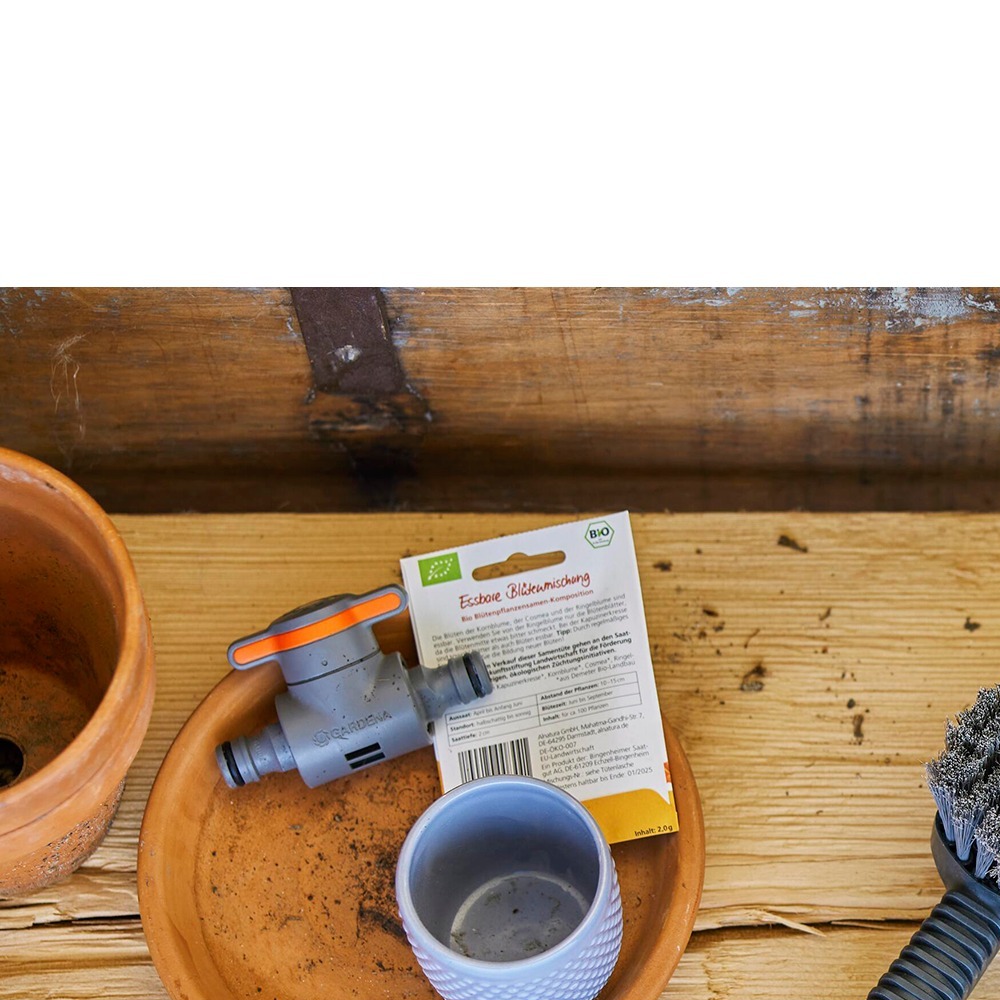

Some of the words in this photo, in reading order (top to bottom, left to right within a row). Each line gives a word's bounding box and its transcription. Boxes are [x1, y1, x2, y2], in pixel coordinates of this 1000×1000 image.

[460, 593, 501, 608] Essbare
[506, 574, 590, 598] Blütenmischung
[475, 591, 593, 618] Blütenpflanzensamen-Komposition
[477, 622, 512, 631] Kornblume,
[525, 613, 549, 621] Cosmea
[576, 598, 611, 609] Ringelblume
[573, 624, 590, 632] Durch
[591, 615, 628, 626] regelmäßiges
[455, 640, 489, 651] Blütenmitte
[581, 609, 627, 622] Kapuzinerkresse
[456, 633, 490, 643] Verwenden
[526, 617, 563, 628] Ringelblume
[492, 658, 516, 667] Verkauf
[538, 646, 570, 657] Samentüte
[572, 641, 591, 649] gehen
[502, 647, 524, 655] Bildung
[544, 636, 564, 646] Blüten!
[490, 662, 532, 674] kunftsstiftung
[533, 650, 578, 665] Landwirtschaft
[600, 638, 632, 648] Förderung
[510, 665, 550, 677] ökologischen
[552, 649, 616, 667] Züchtungsinitiativen.
[571, 669, 596, 679] Demeter
[598, 661, 635, 672] Bio-Landbau
[541, 692, 563, 700] Abstand
[542, 702, 566, 711] Blütezeit:
[587, 692, 613, 700] September
[330, 711, 392, 739] GARDENA
[477, 717, 506, 725] halbschattig
[539, 736, 566, 746] DE-64295
[567, 730, 597, 740] Darmstadt,
[598, 723, 628, 733] alnatura.de
[540, 742, 576, 755] DE-ÖKO-007
[541, 746, 594, 761] EU-Landwirtschaft
[552, 759, 575, 767] Produkt
[590, 748, 630, 759] Bingenheimer
[565, 761, 593, 772] DE-61209
[594, 752, 649, 765] Echzell-Bingenheim
[601, 763, 634, 772] Tütenlasche
[627, 767, 653, 776] 01/2025
